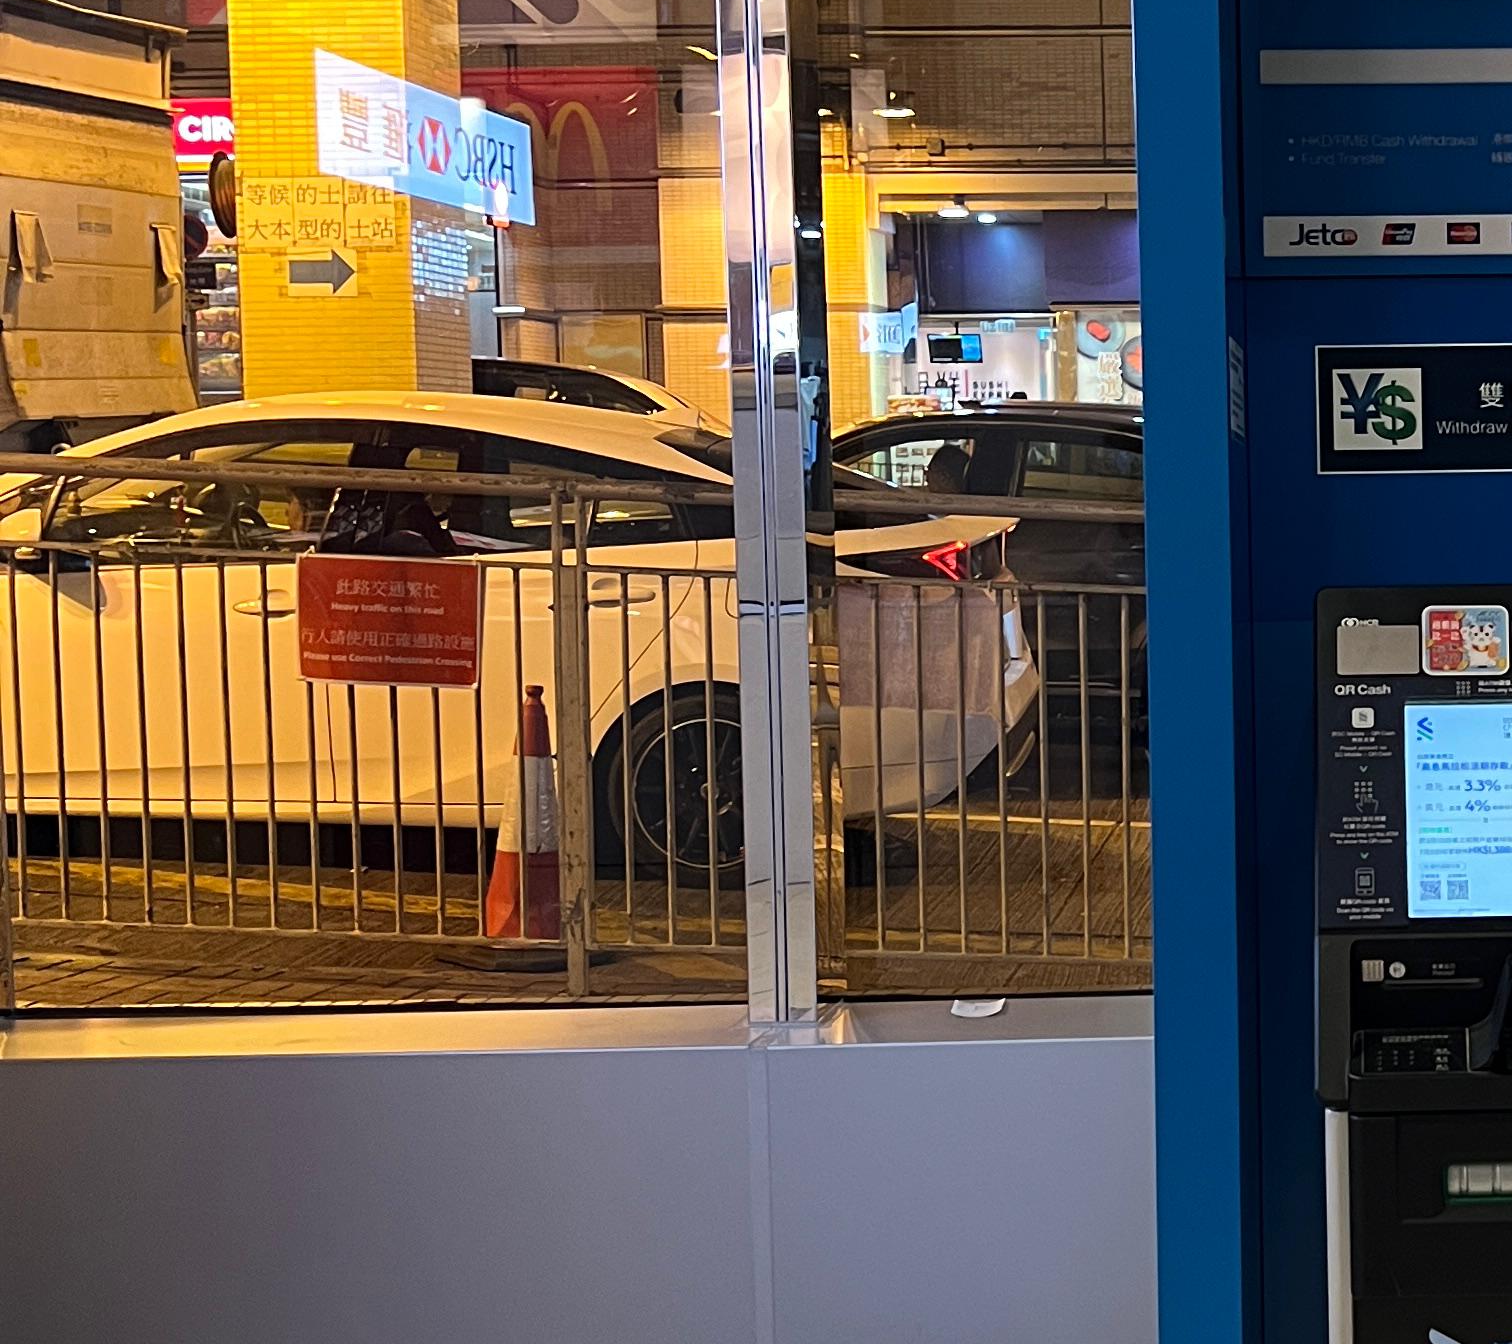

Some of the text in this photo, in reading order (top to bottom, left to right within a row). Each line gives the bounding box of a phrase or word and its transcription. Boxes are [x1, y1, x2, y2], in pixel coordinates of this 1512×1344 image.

[248, 217, 394, 241] 大本型的士站
[1436, 419, 1508, 436] Withdraw
[335, 578, 441, 599] 此路交通繁忙
[331, 601, 359, 614] Heavy
[361, 602, 388, 613] traffic
[349, 652, 383, 664] Correct
[1334, 683, 1392, 696] QR Cash
[1463, 779, 1502, 792] 3.3%
[1464, 799, 1492, 812] 4%
